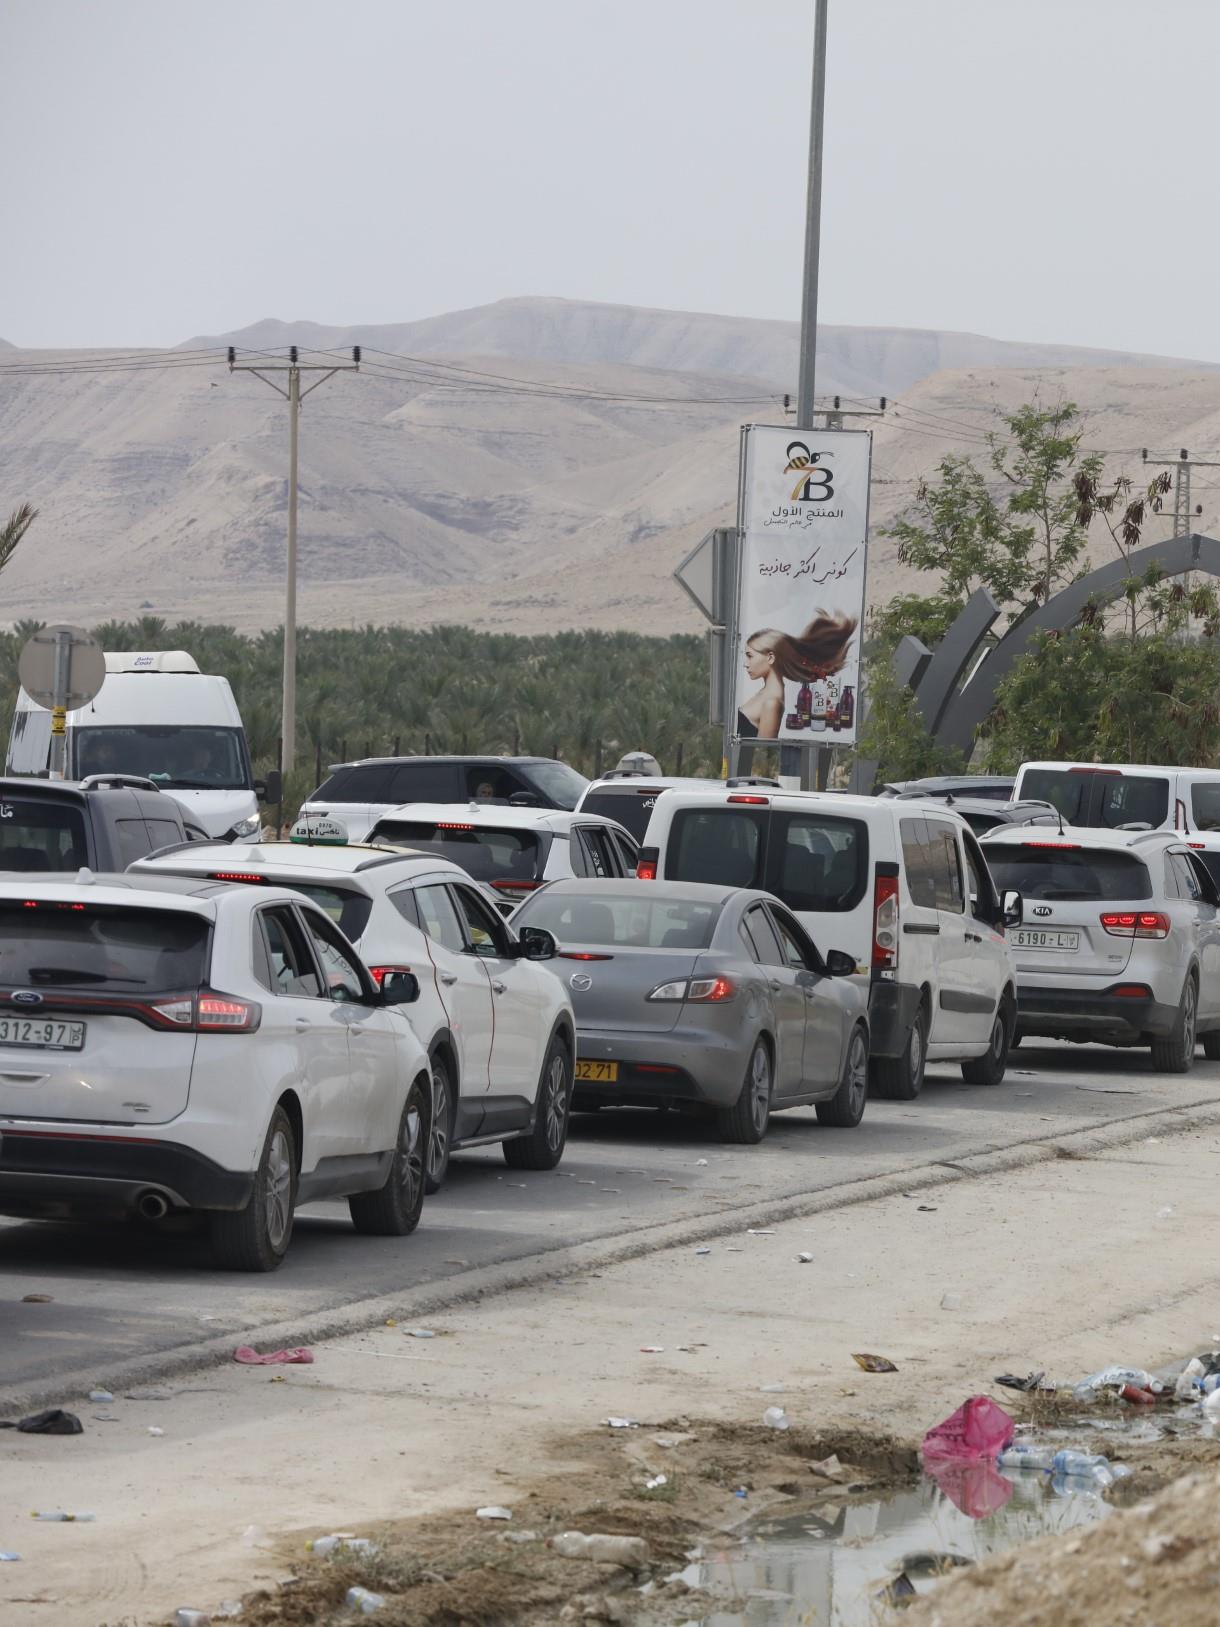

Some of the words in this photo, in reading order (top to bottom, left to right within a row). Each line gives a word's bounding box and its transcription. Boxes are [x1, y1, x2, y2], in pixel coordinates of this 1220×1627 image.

[772, 506, 802, 518] الأول
[806, 508, 844, 521] المنتج
[759, 558, 792, 577] جاذبية
[812, 547, 858, 585] كوني
[296, 827, 319, 836] taxi
[1035, 907, 1051, 915] KIA
[596, 1063, 612, 1079] 71
